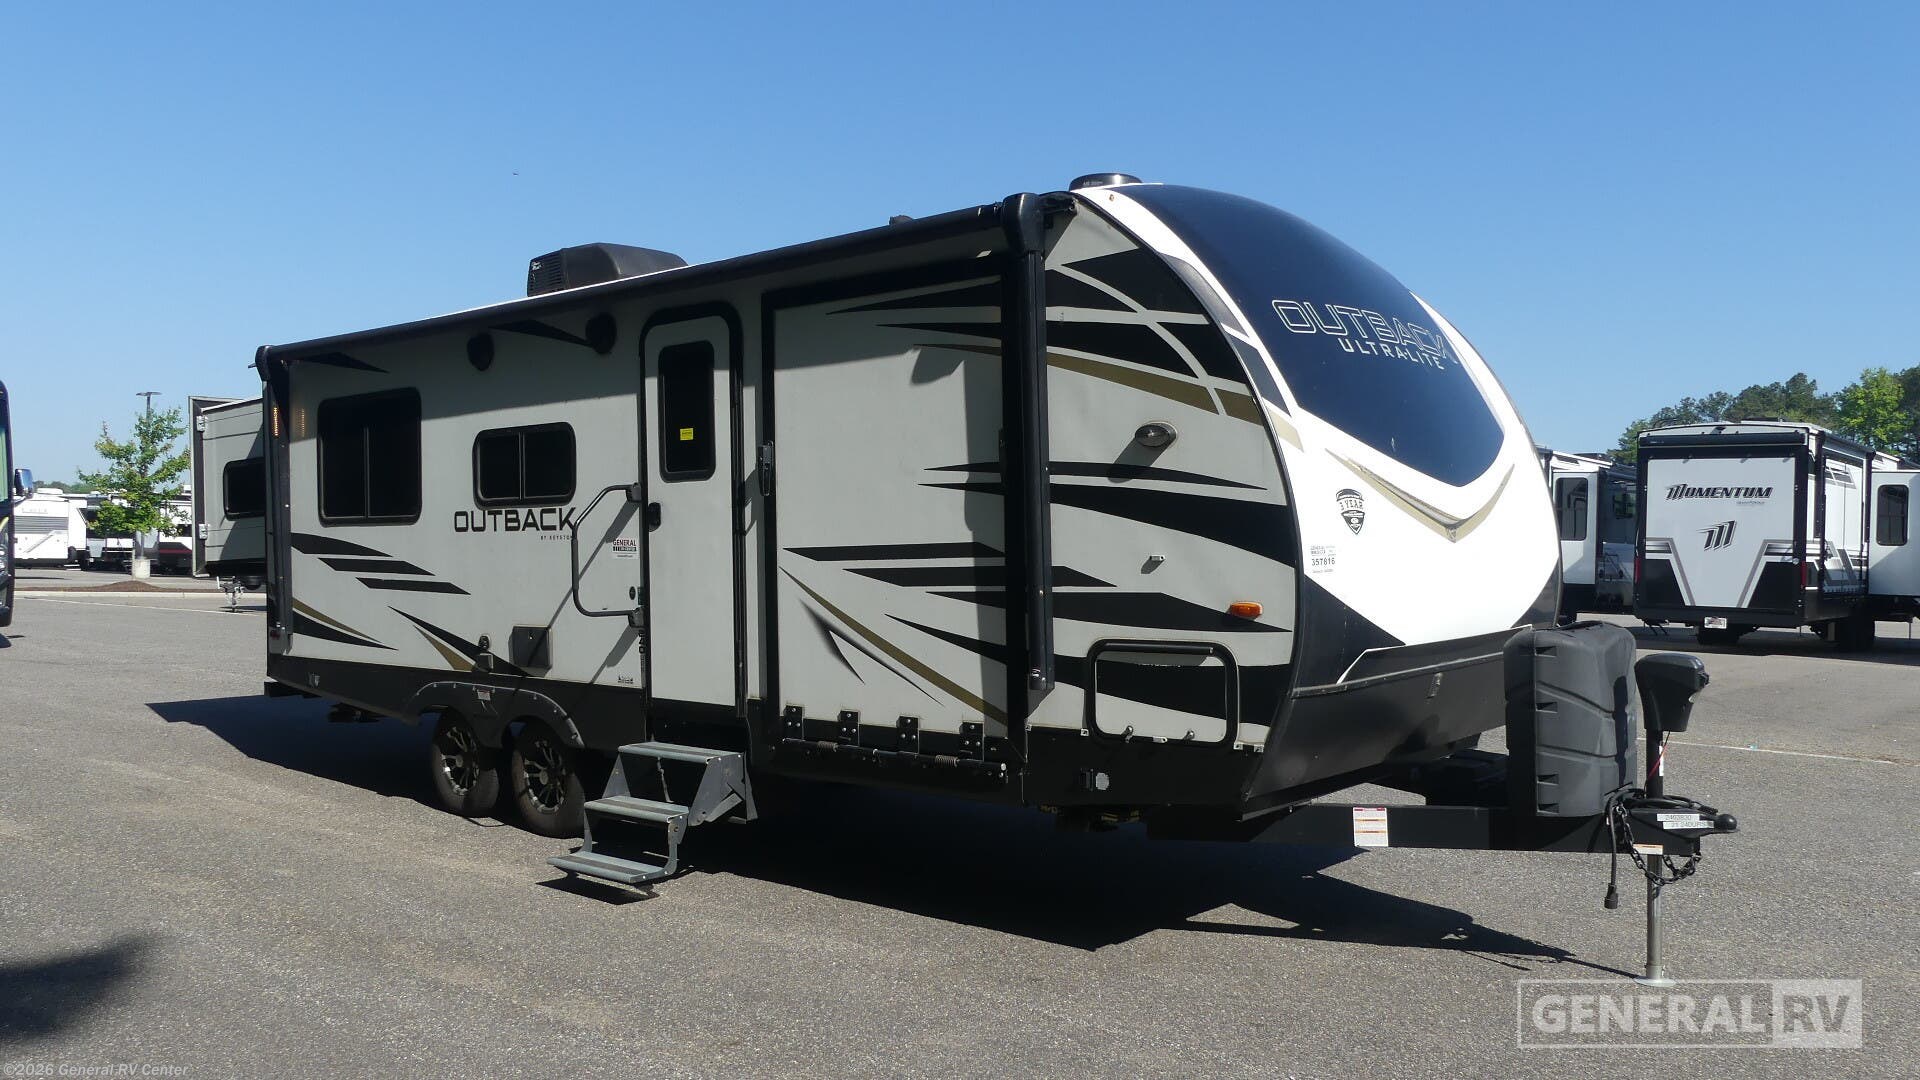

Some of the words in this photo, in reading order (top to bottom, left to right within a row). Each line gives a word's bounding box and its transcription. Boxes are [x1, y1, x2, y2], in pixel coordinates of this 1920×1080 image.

[1664, 483, 1774, 501] MOMENTUM
[1344, 499, 1364, 510] YEAR
[454, 507, 577, 532] OUTBACK
[612, 539, 637, 547] GENERAL
[1311, 557, 1336, 567] 357816
